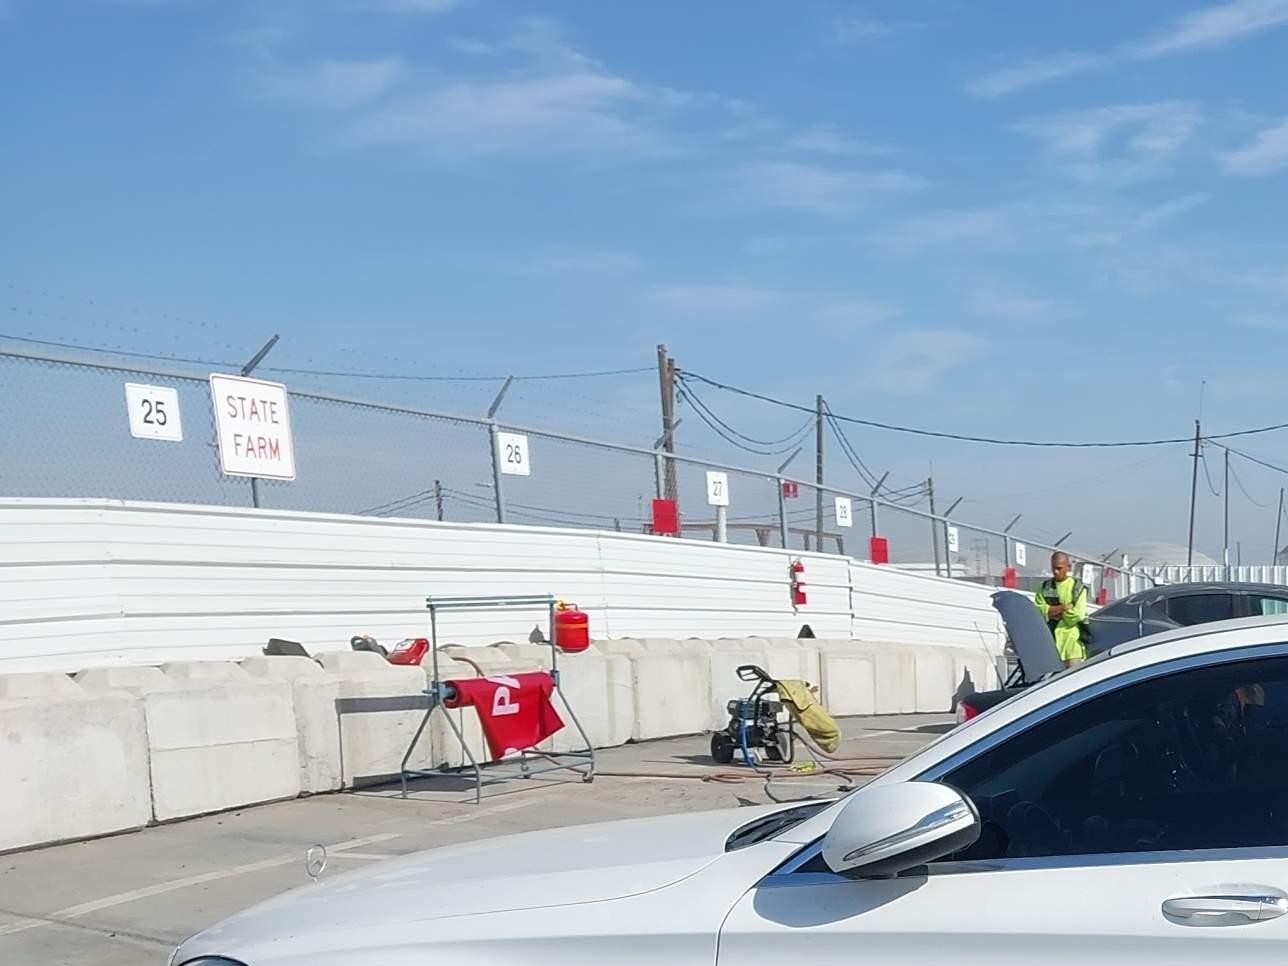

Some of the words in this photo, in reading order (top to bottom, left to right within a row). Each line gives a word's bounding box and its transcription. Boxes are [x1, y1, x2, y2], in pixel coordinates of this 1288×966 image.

[141, 398, 168, 426] 25
[226, 395, 280, 424] STATE
[233, 433, 281, 461] FARM
[506, 444, 522, 465] 26
[713, 480, 722, 497] 27
